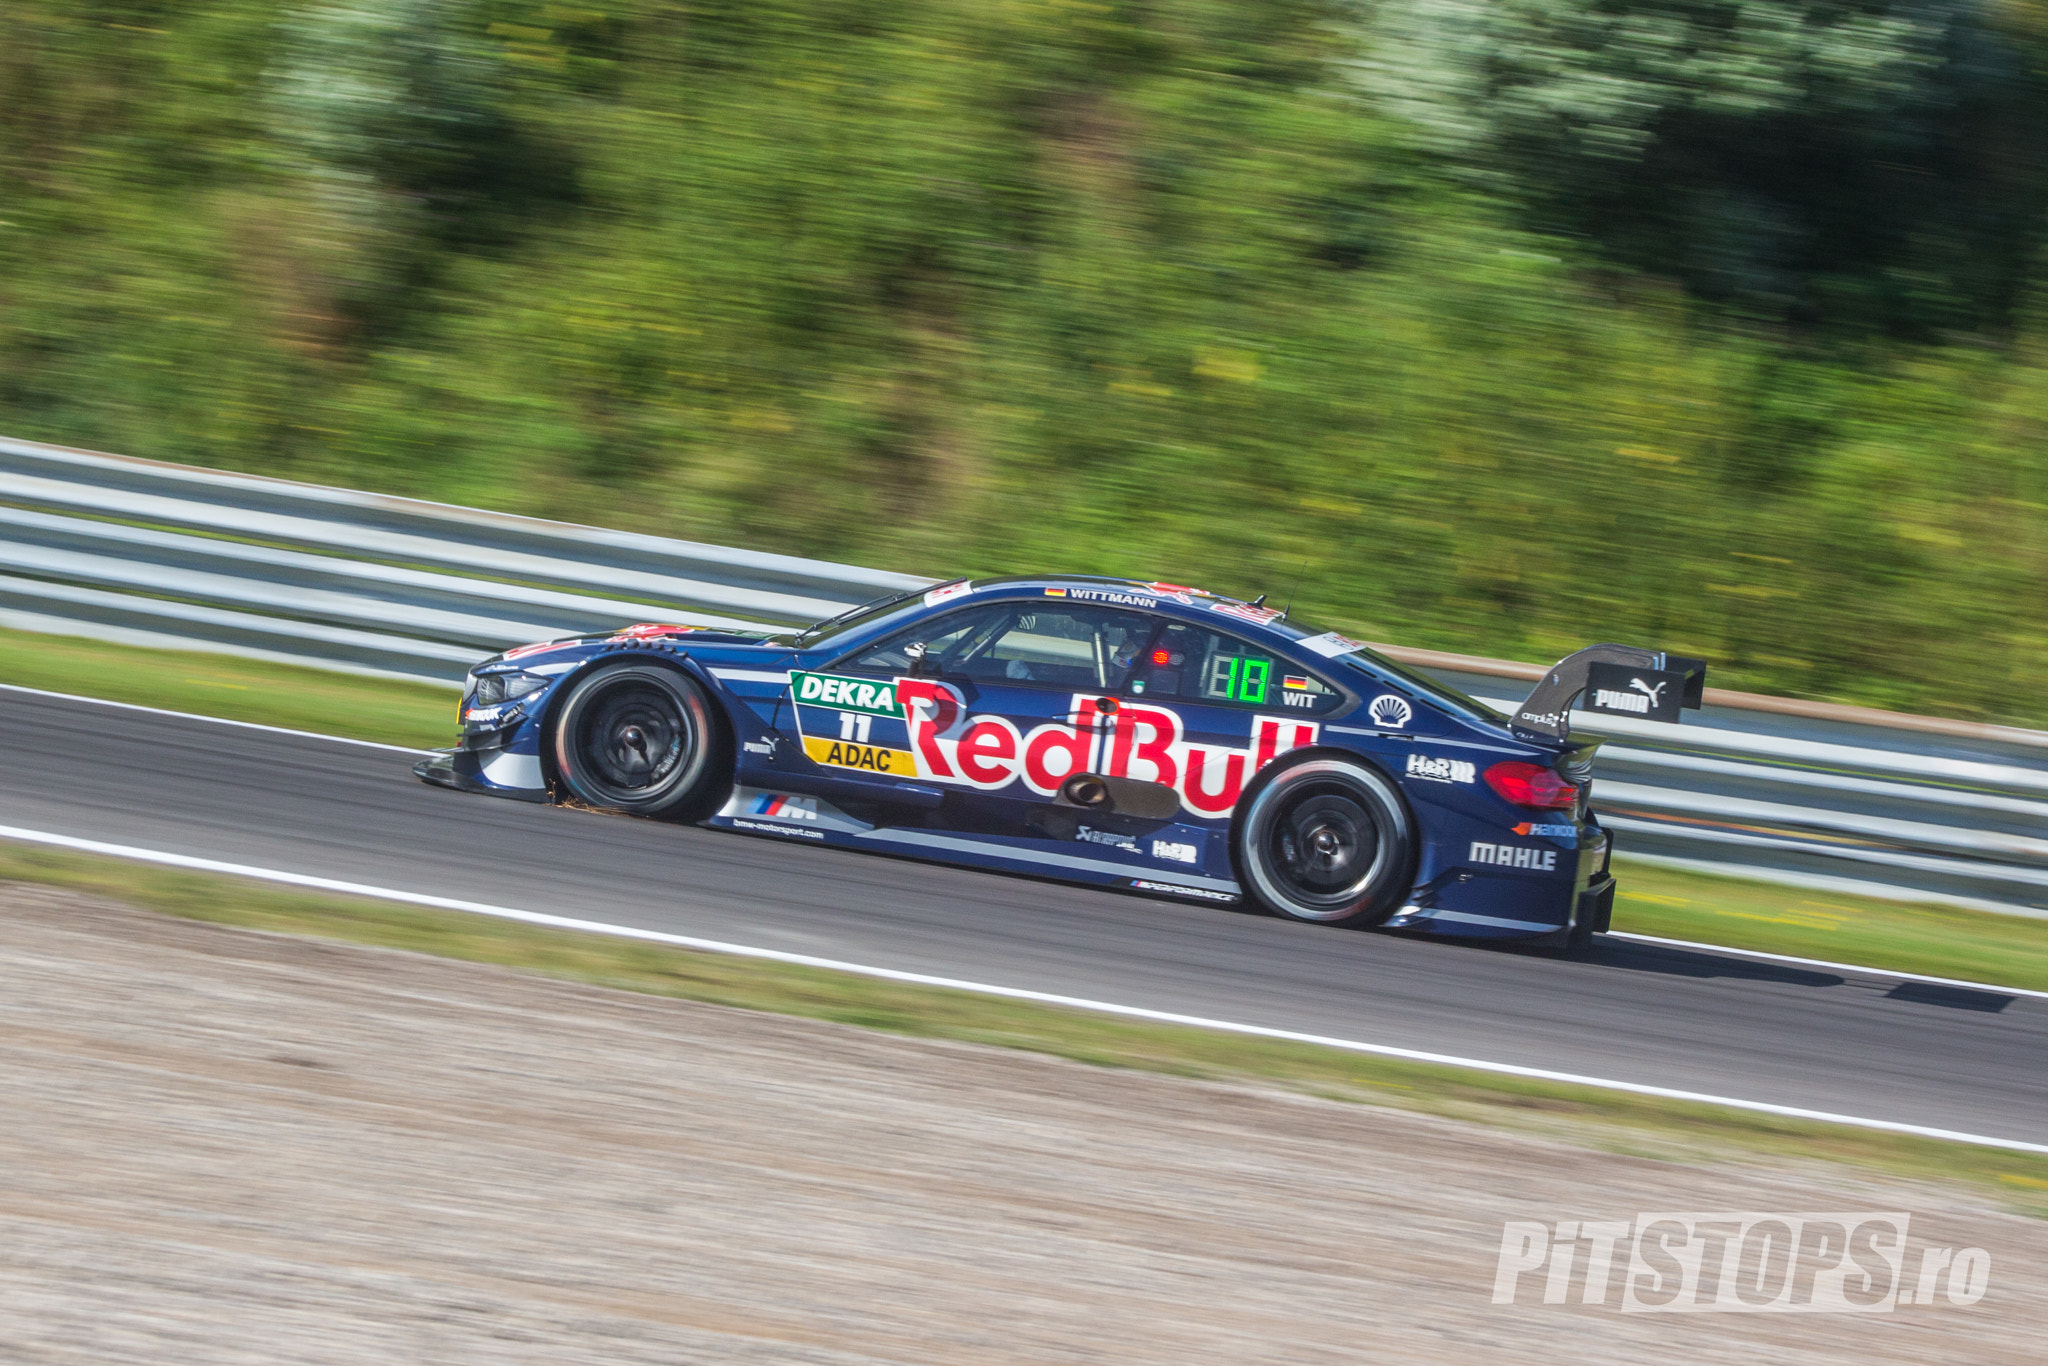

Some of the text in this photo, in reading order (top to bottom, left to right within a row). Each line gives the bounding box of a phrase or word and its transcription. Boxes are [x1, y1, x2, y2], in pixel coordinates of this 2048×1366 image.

[1070, 588, 1157, 608] WITTMANN
[800, 676, 894, 712] DEKRA
[1282, 691, 1318, 708] WIT
[1595, 689, 1649, 713] PUMA
[839, 711, 872, 743] 11
[827, 742, 891, 771] ADAC
[896, 679, 1314, 813] Red Bu
[1468, 841, 1557, 871] MAHLE
